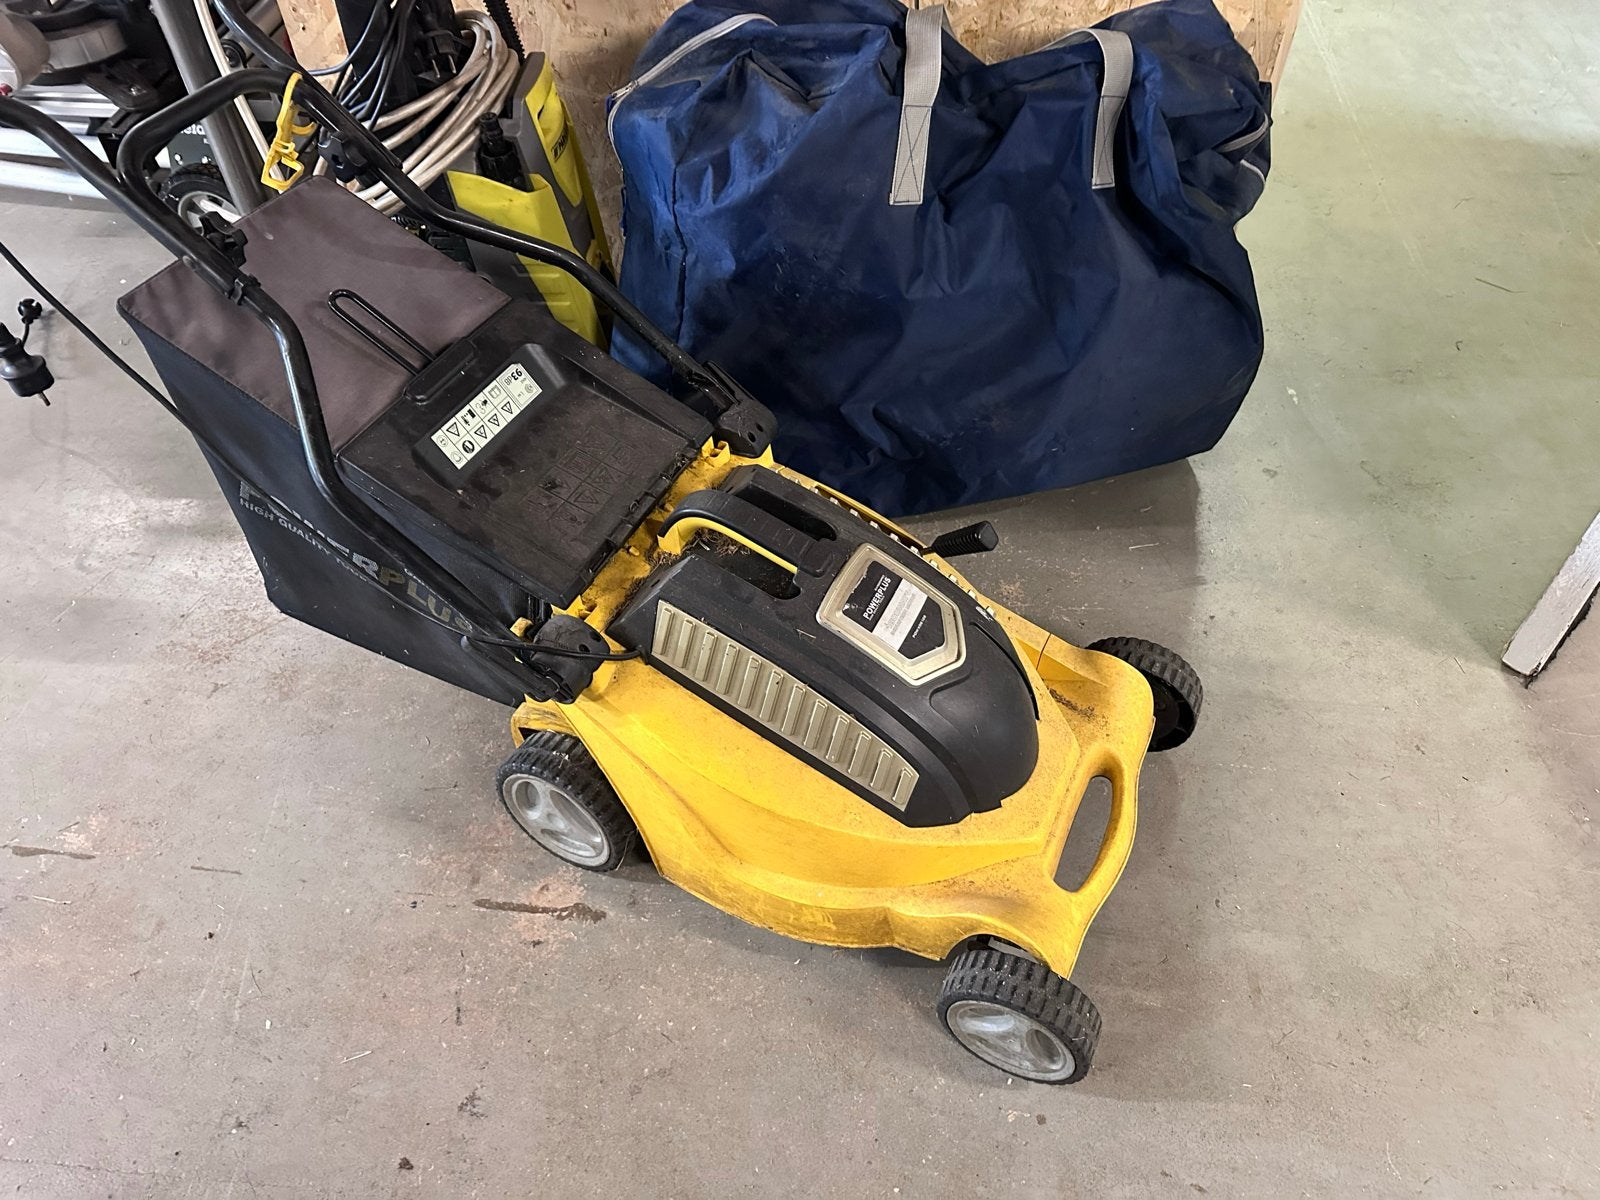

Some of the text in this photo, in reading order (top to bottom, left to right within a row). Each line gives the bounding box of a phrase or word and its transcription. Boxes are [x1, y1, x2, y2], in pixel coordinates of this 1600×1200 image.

[511, 368, 523, 381] 93
[240, 498, 275, 521] HIGH
[862, 576, 891, 620] POWERPLUS
